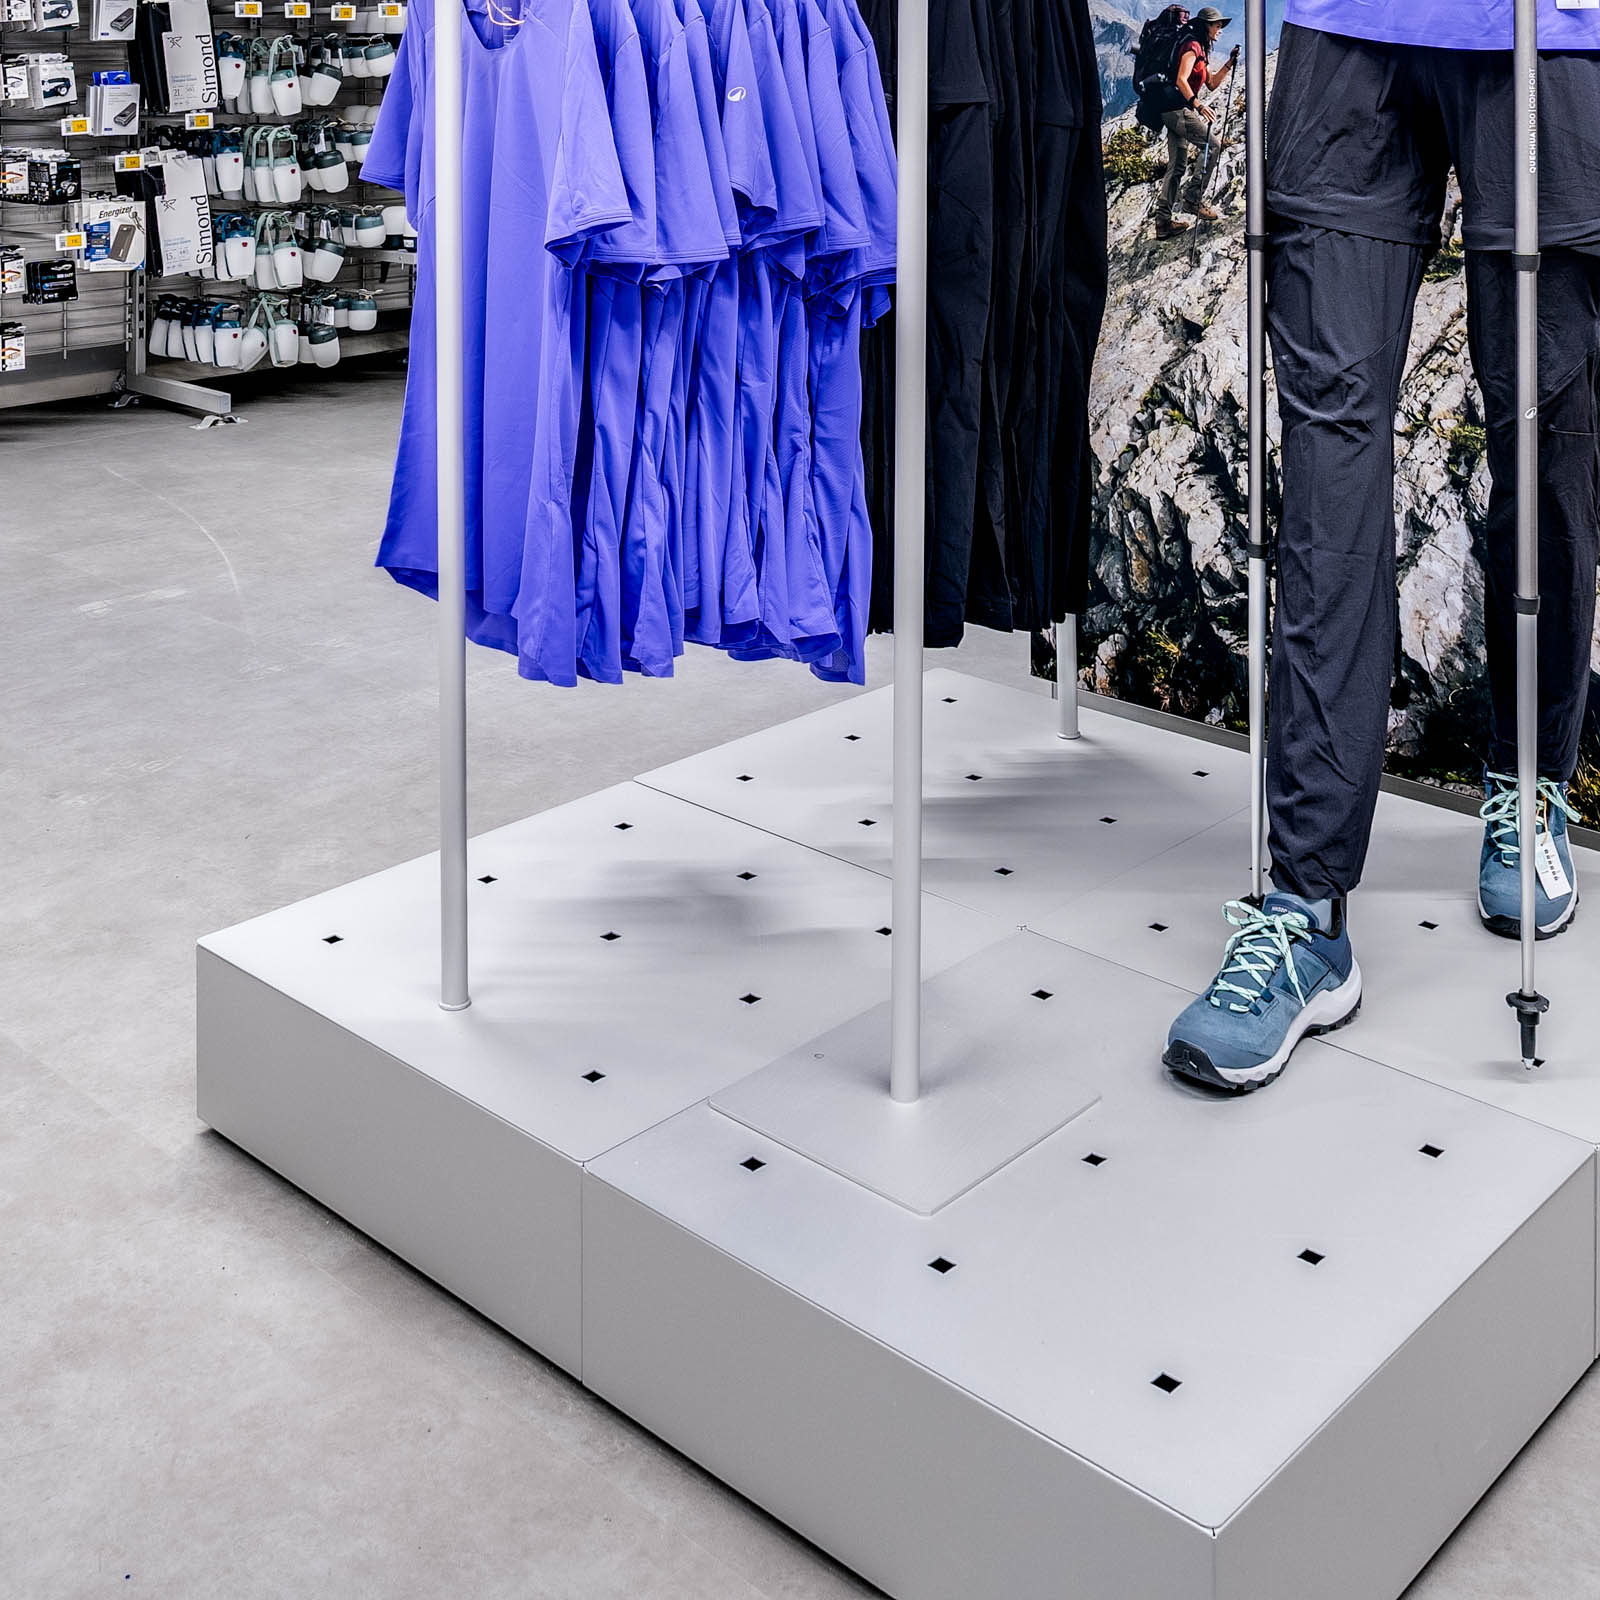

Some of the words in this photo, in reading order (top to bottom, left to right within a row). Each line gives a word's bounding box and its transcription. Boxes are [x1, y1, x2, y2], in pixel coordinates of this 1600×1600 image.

[195, 34, 217, 104] Simond
[99, 205, 133, 219] Energizer
[190, 194, 213, 264] Simond
